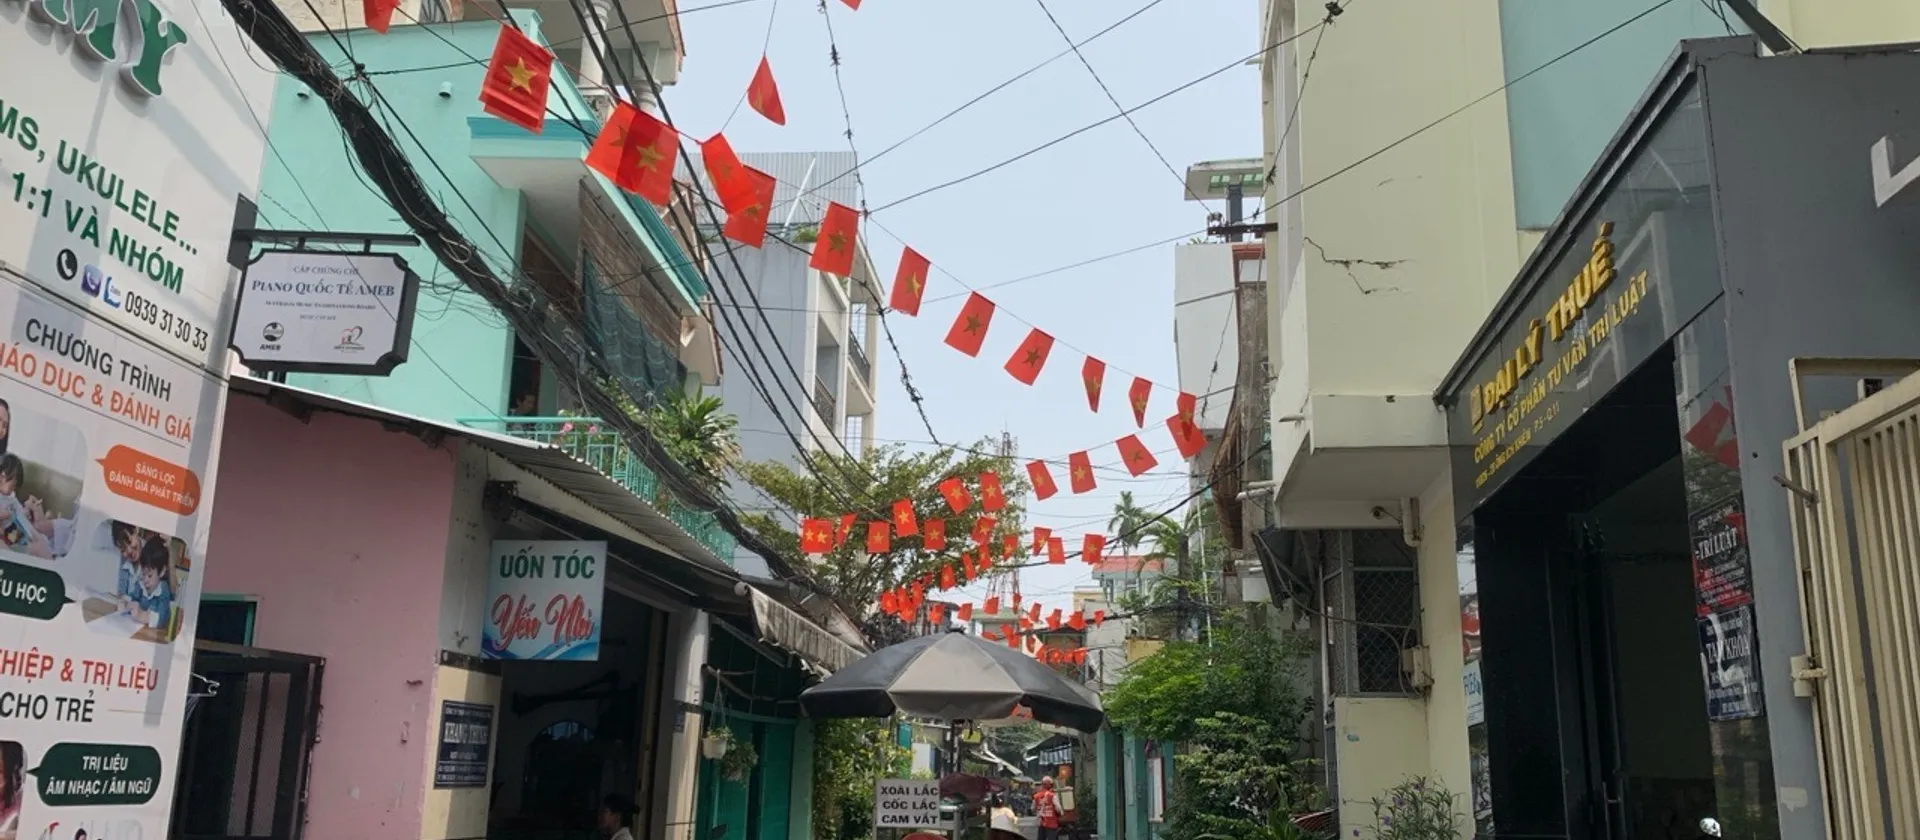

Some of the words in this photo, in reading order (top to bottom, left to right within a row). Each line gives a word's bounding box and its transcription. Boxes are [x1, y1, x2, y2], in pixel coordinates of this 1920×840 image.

[56, 139, 198, 256] UKULELE...
[12, 171, 53, 218] 1:1
[65, 199, 99, 248] VÀ
[108, 228, 184, 294] NHÓM
[252, 280, 293, 293] PIANO
[295, 278, 334, 296] QUỐC
[337, 280, 352, 295] TẾ
[355, 284, 395, 297] AMEB
[124, 291, 158, 326] 0939
[159, 308, 174, 335] 31
[174, 316, 191, 344] 30
[192, 326, 209, 352] 33
[1483, 358, 1518, 414] ĐẠI
[1514, 318, 1546, 382] LÝ
[1545, 220, 1617, 343] THUẾ
[25, 318, 113, 377] CHƯƠNG
[120, 359, 172, 402] TRÌNH
[259, 343, 281, 351] AMEB
[1474, 433, 1496, 464] CÔNG
[1587, 304, 1610, 349] TRÍ
[1611, 269, 1649, 327] LUẬT
[42, 361, 86, 399] DỤC
[91, 384, 104, 407] &
[110, 390, 160, 429] ĐÁNH
[164, 414, 192, 443] GIÁ
[109, 470, 133, 488] ĐÁNH
[134, 479, 149, 492] GIÁ
[150, 483, 171, 500] PHÁT
[159, 473, 175, 486] LỌC
[500, 544, 545, 578] UỐN
[552, 548, 595, 579] TÓC
[15, 582, 48, 605] HỌC
[491, 593, 542, 652] Yến
[0, 646, 54, 684] HIỆP
[60, 658, 74, 683] &
[82, 660, 113, 691] TRỊ
[117, 661, 159, 695] LIỆU
[0, 691, 49, 720] CHO
[55, 689, 95, 723] TRẺ
[82, 756, 101, 773] TRỊ
[103, 753, 129, 773] LIỆU
[45, 776, 66, 795] ÂM
[68, 779, 101, 798] NHẠC
[108, 776, 126, 795] ÂM
[127, 776, 153, 795] NGỮ
[882, 814, 909, 824] CAM
